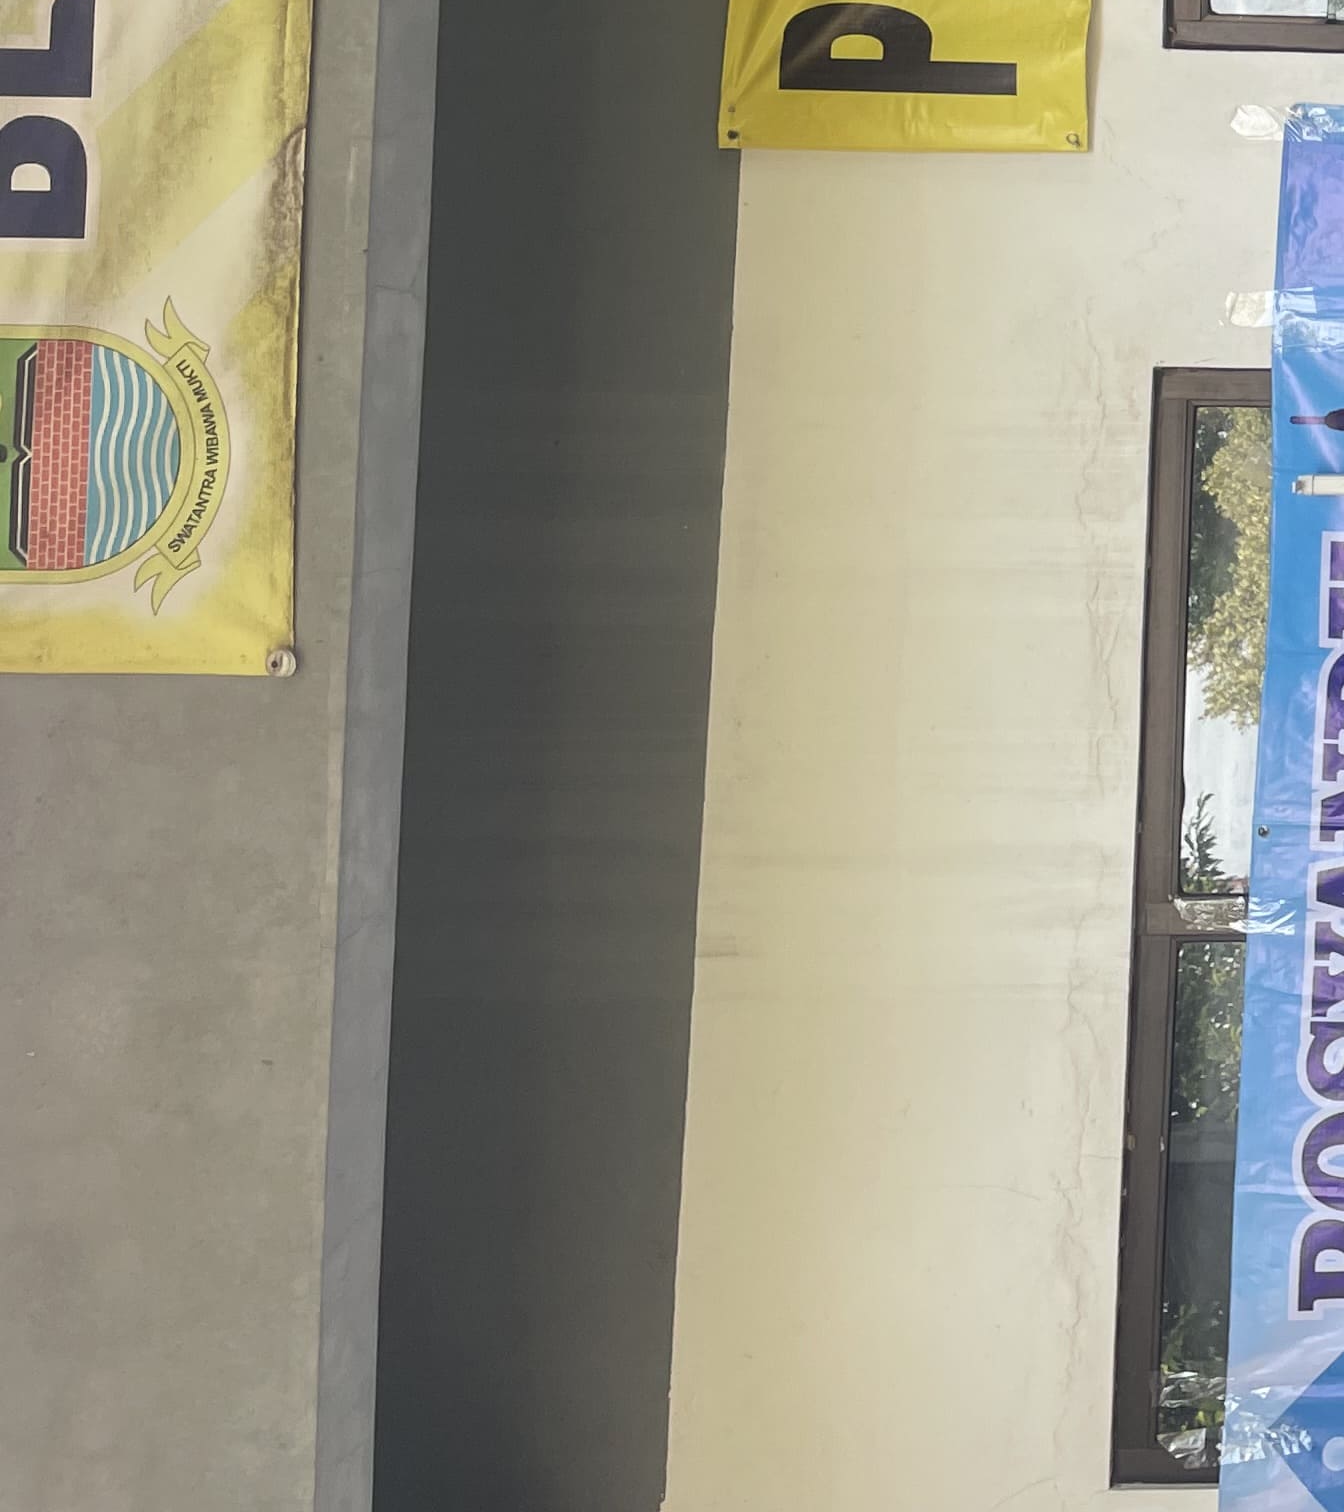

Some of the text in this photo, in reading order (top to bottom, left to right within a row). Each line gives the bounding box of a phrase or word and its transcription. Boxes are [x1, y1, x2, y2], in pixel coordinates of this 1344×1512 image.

[168, 358, 219, 552] SWATANTRA WIBAWA MUKTI
